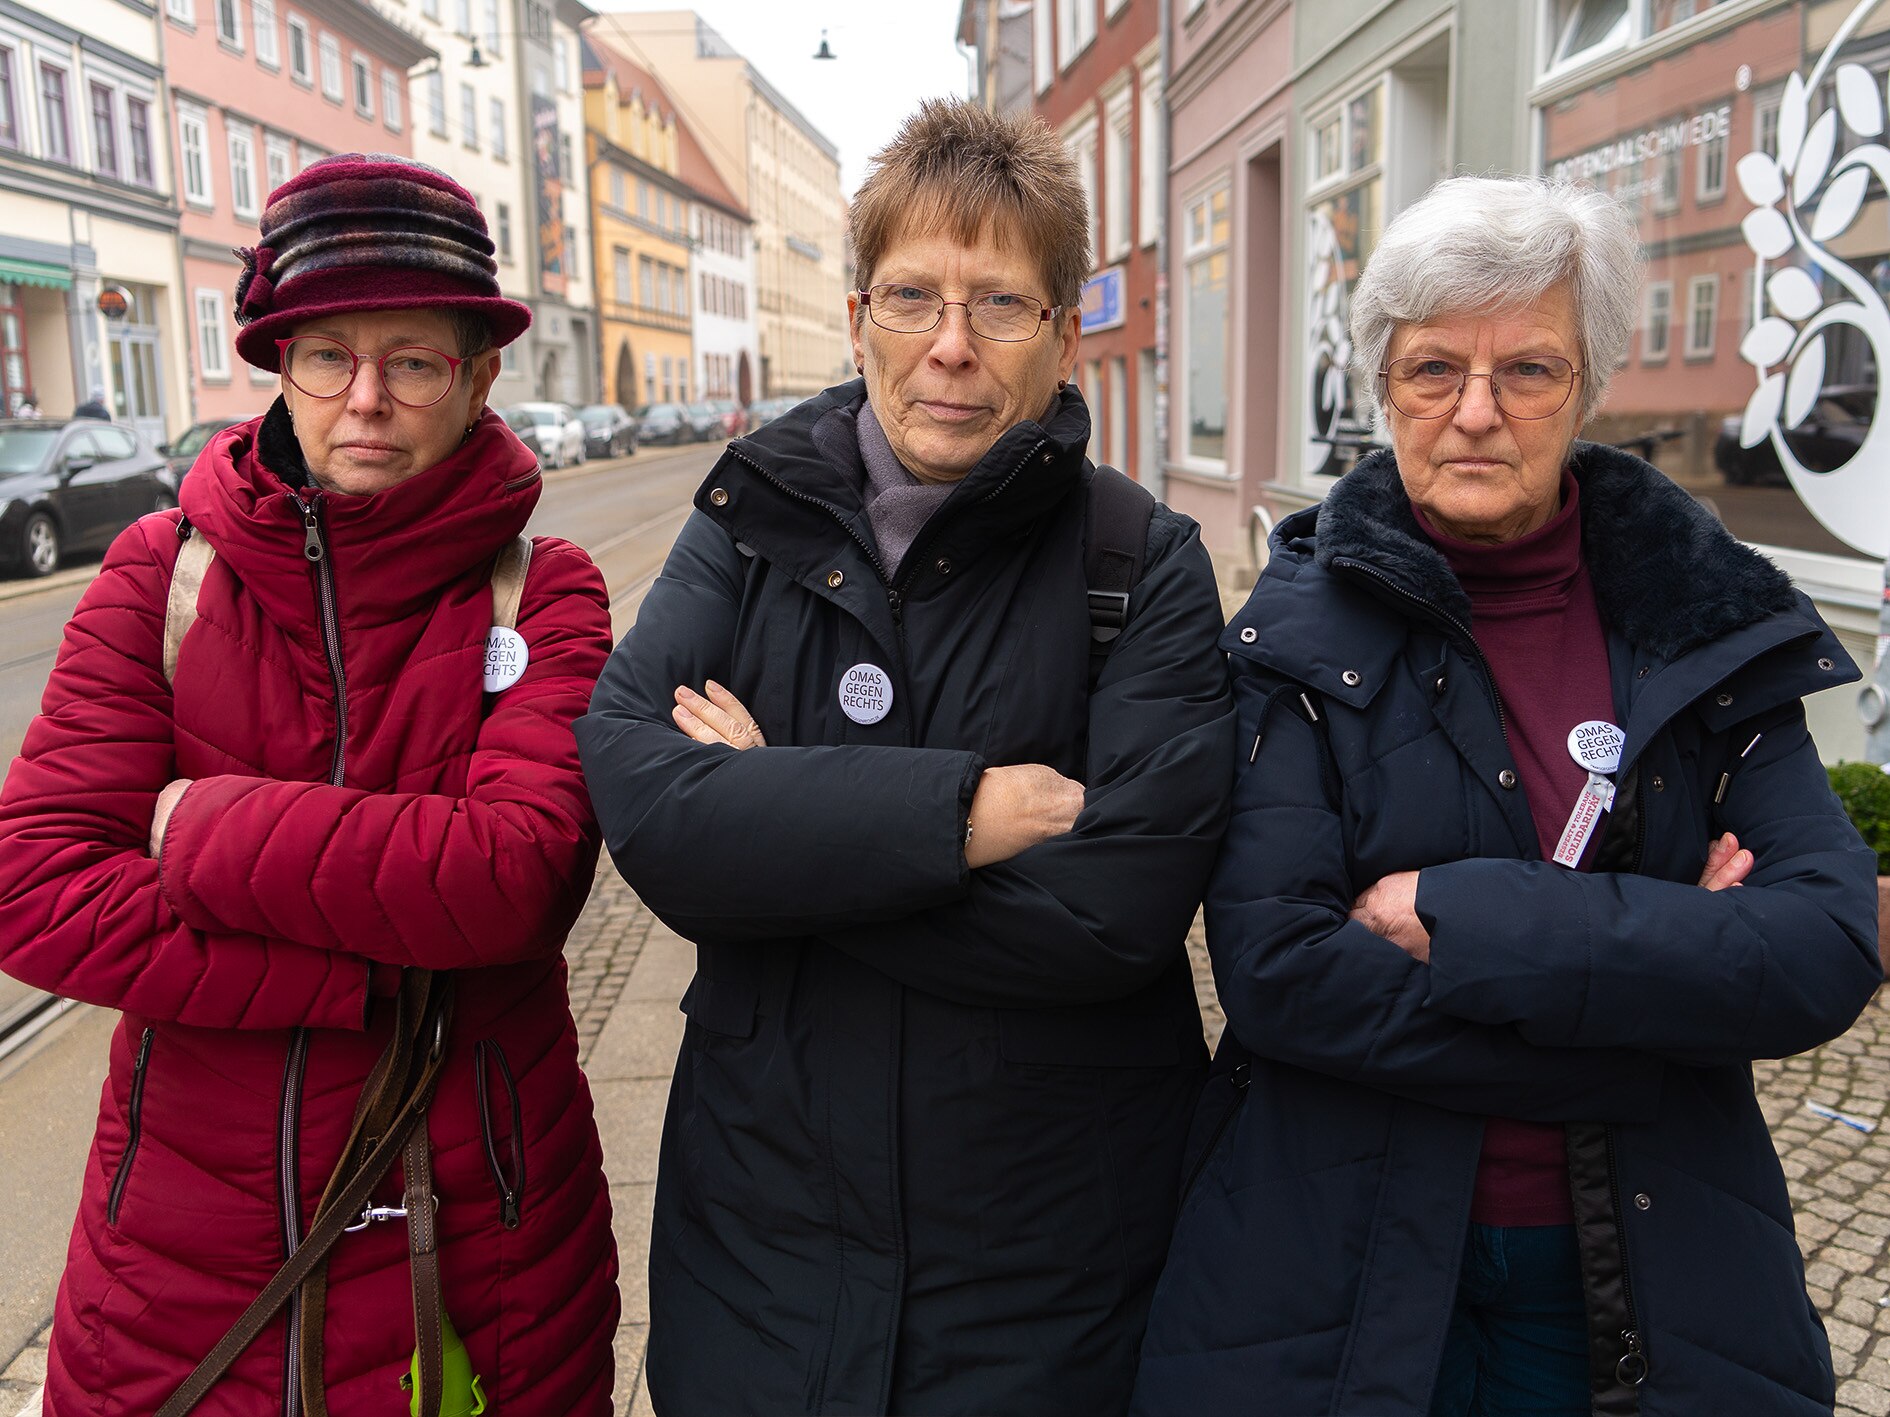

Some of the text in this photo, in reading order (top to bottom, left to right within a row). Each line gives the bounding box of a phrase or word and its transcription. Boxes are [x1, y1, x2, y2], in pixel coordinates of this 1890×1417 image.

[486, 637, 515, 649] MAS
[484, 650, 516, 662] EGEN
[483, 664, 517, 676] CHTS
[849, 670, 882, 685] OMAS
[845, 682, 883, 698] GEGEN
[843, 695, 884, 711] RECHTS
[1575, 723, 1613, 739] OMAS
[1577, 733, 1621, 750] GEGEN
[1564, 794, 1601, 863] SOLIDARITÄT
